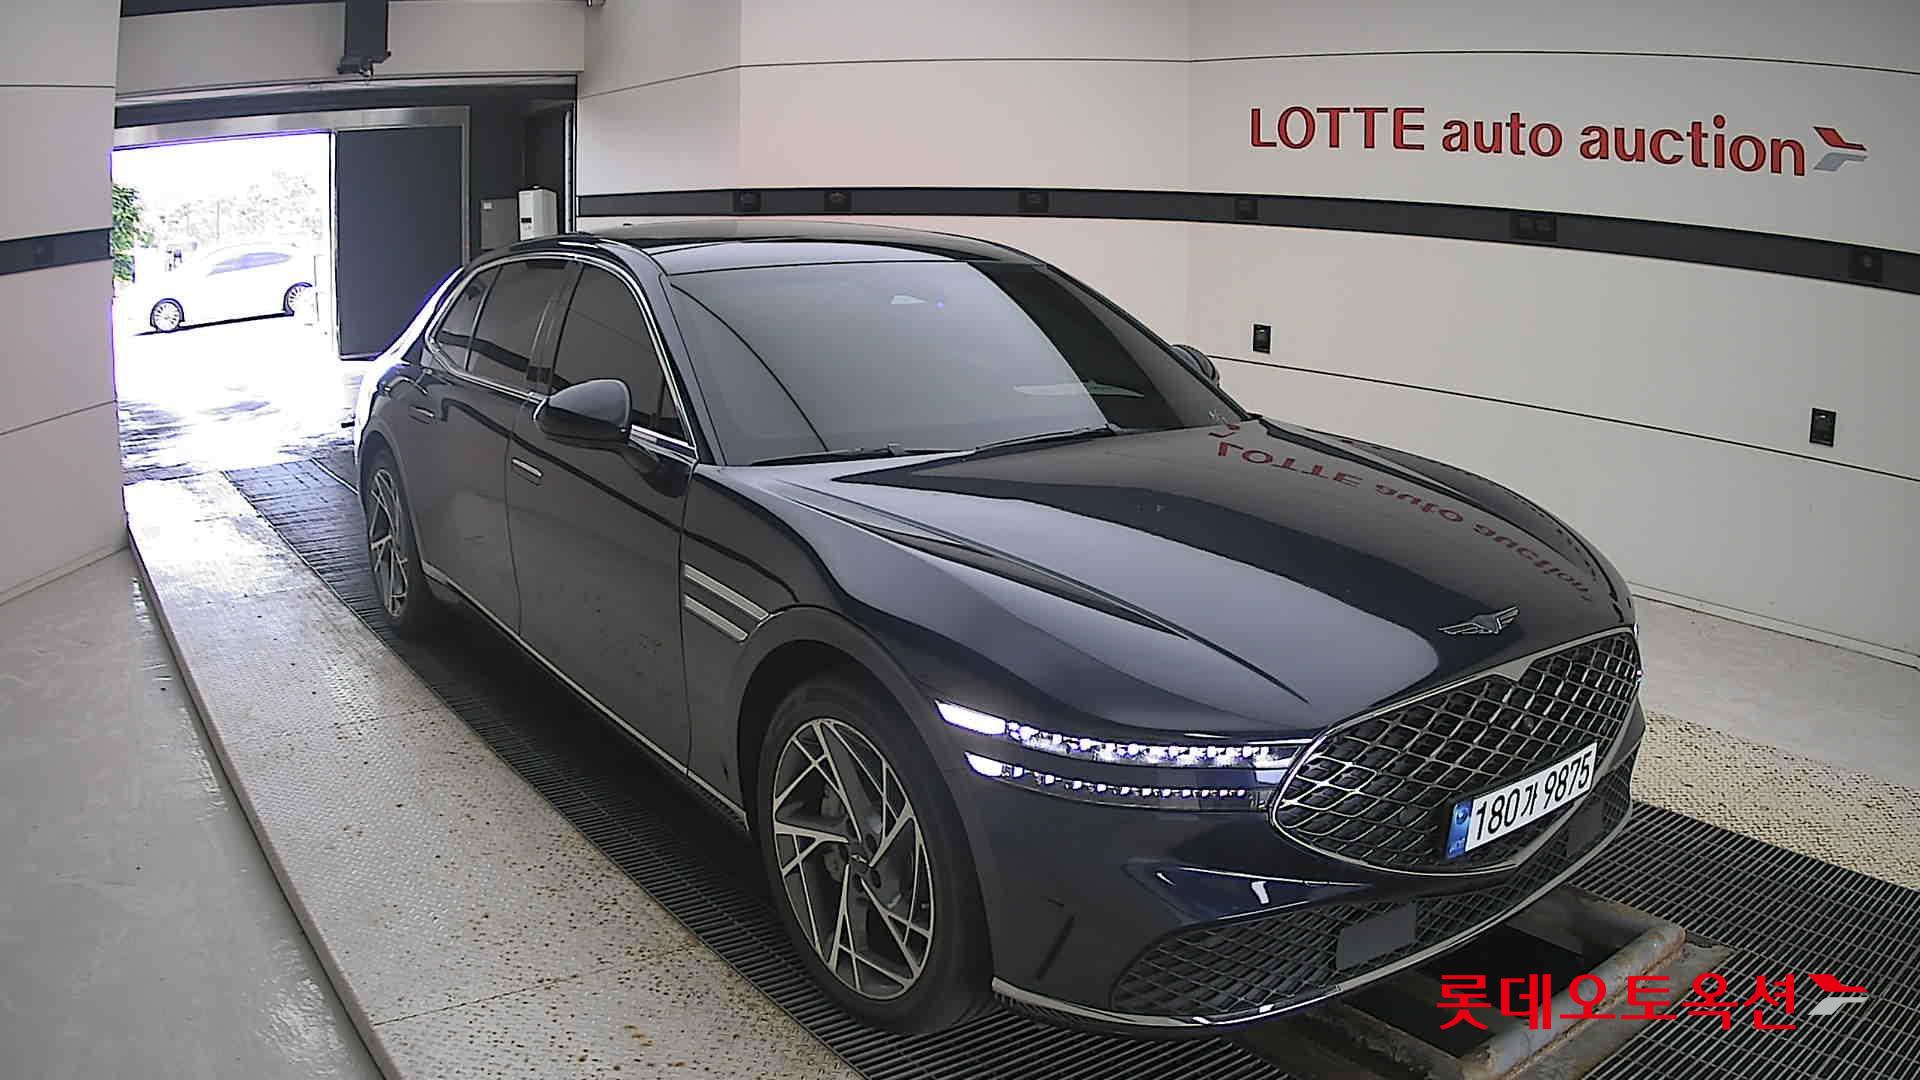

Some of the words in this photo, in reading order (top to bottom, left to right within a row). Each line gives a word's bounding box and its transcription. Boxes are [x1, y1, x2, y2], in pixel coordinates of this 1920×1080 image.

[1250, 105, 1425, 151] LOTTE
[1441, 112, 1564, 157] auto
[1579, 115, 1806, 177] auction
[1542, 751, 1593, 810] 9875
